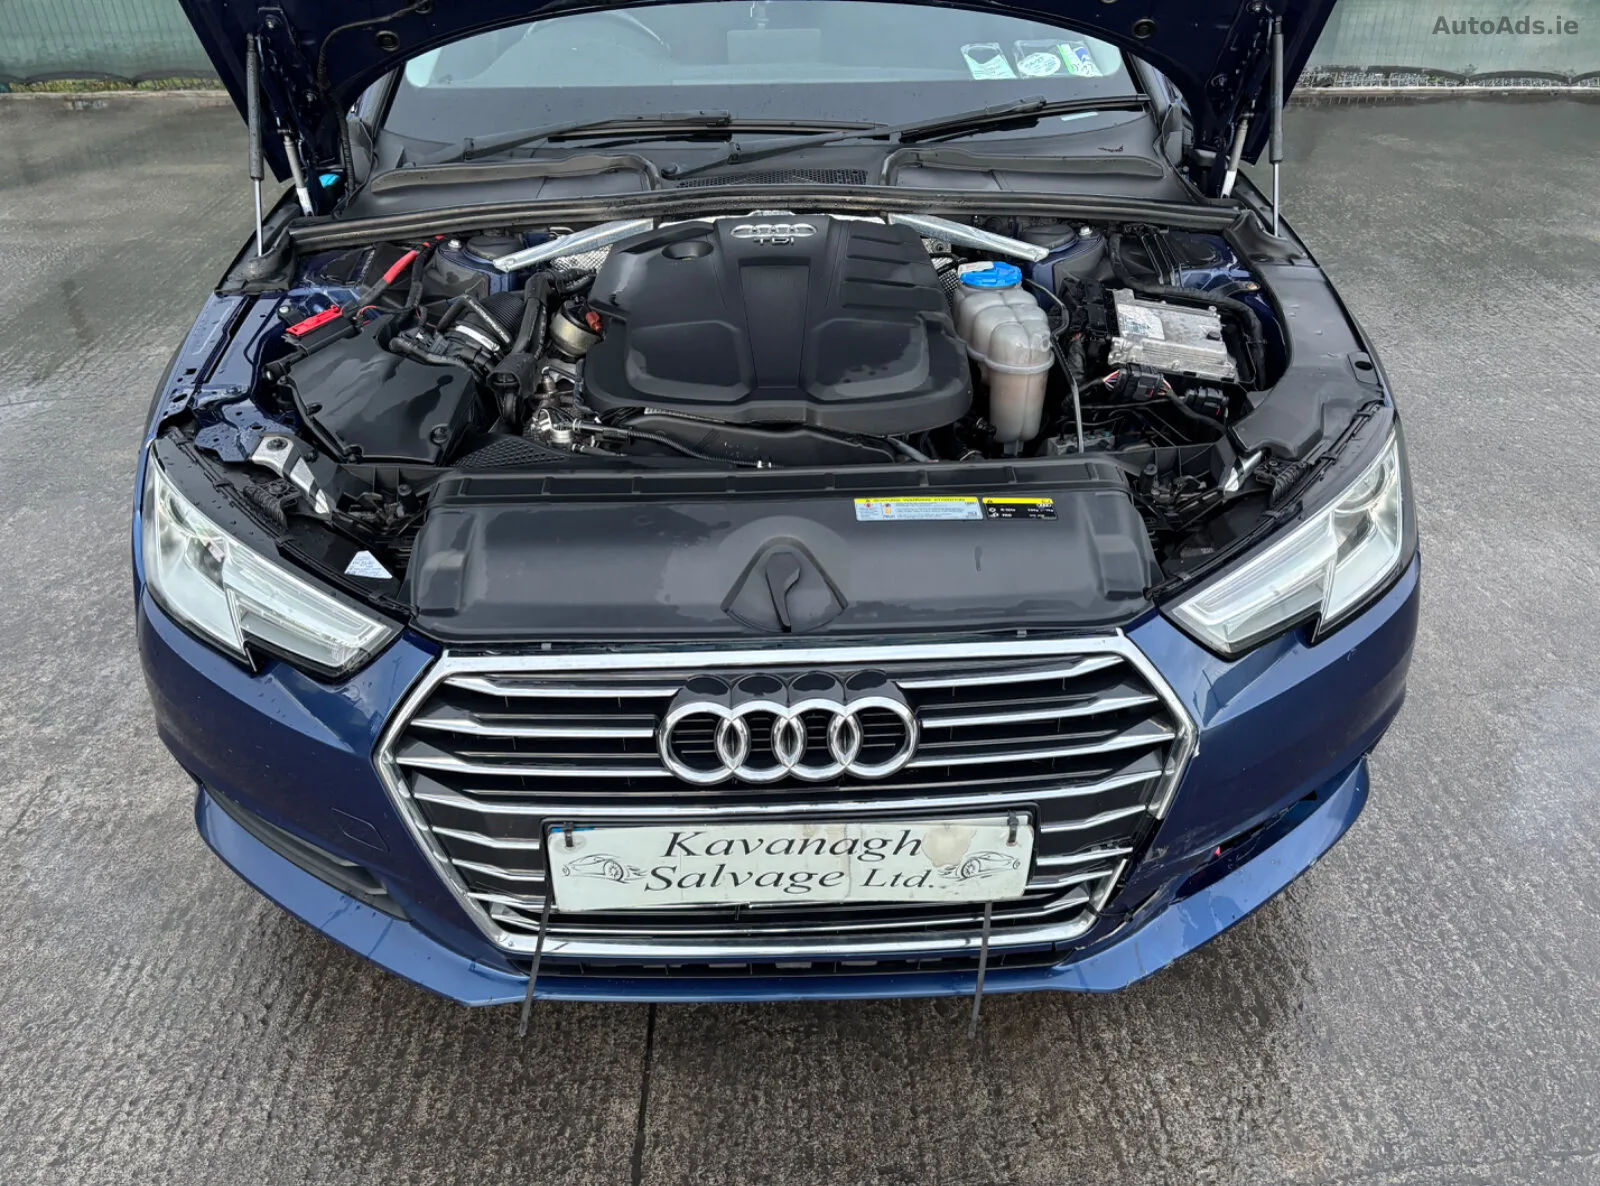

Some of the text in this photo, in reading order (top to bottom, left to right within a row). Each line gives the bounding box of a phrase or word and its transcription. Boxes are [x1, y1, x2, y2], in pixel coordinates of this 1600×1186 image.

[659, 829, 923, 863] Kavanagh
[644, 863, 935, 895] Salvage Ltd.
